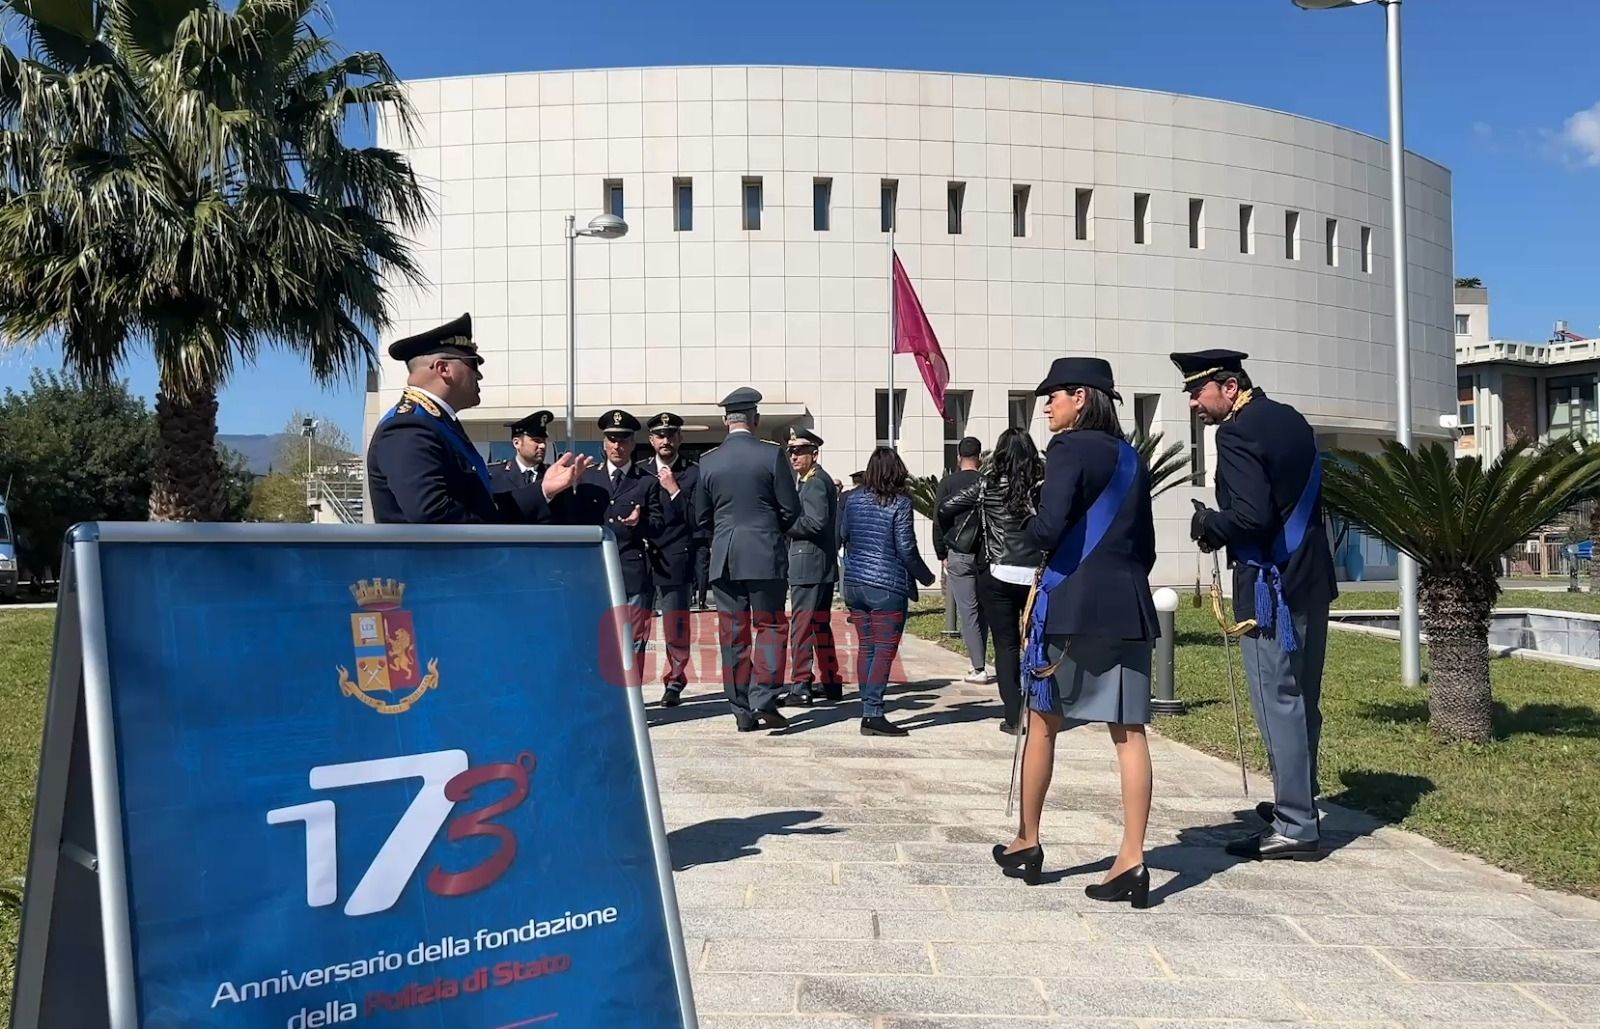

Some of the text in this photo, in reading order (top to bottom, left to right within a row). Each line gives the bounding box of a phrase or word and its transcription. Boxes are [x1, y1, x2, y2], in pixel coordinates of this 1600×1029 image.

[210, 906, 618, 1008] Anniversario della fondazione
[287, 953, 572, 1029] della Polizia di Stato
